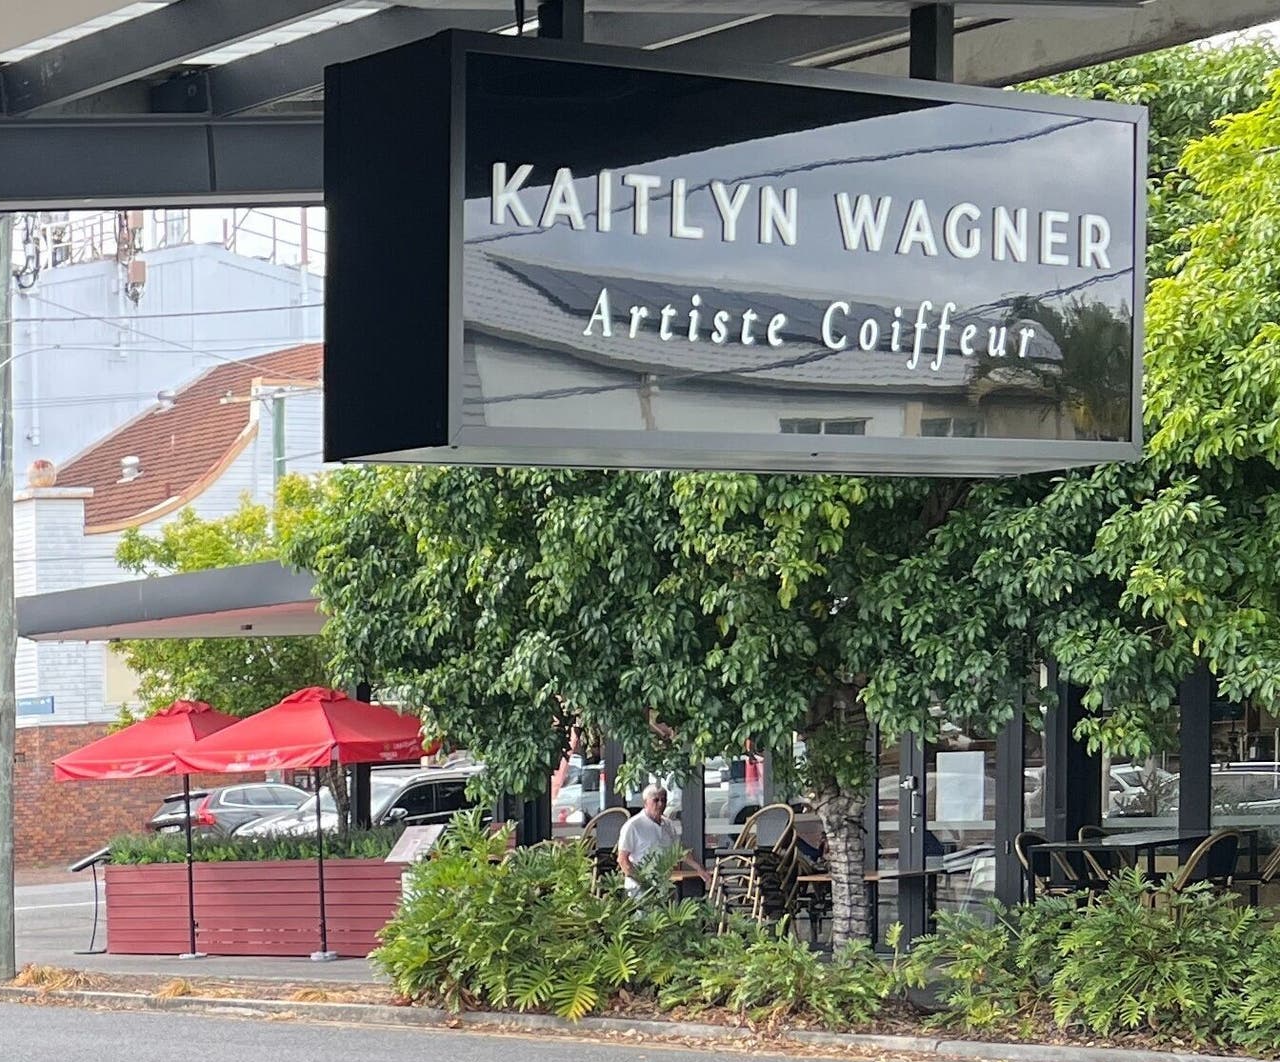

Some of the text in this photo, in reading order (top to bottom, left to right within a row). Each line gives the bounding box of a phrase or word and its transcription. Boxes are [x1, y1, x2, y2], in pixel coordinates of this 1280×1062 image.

[490, 162, 1112, 269] KAITLYN WAGNER
[583, 287, 1037, 373] Artiste Coiffeur
